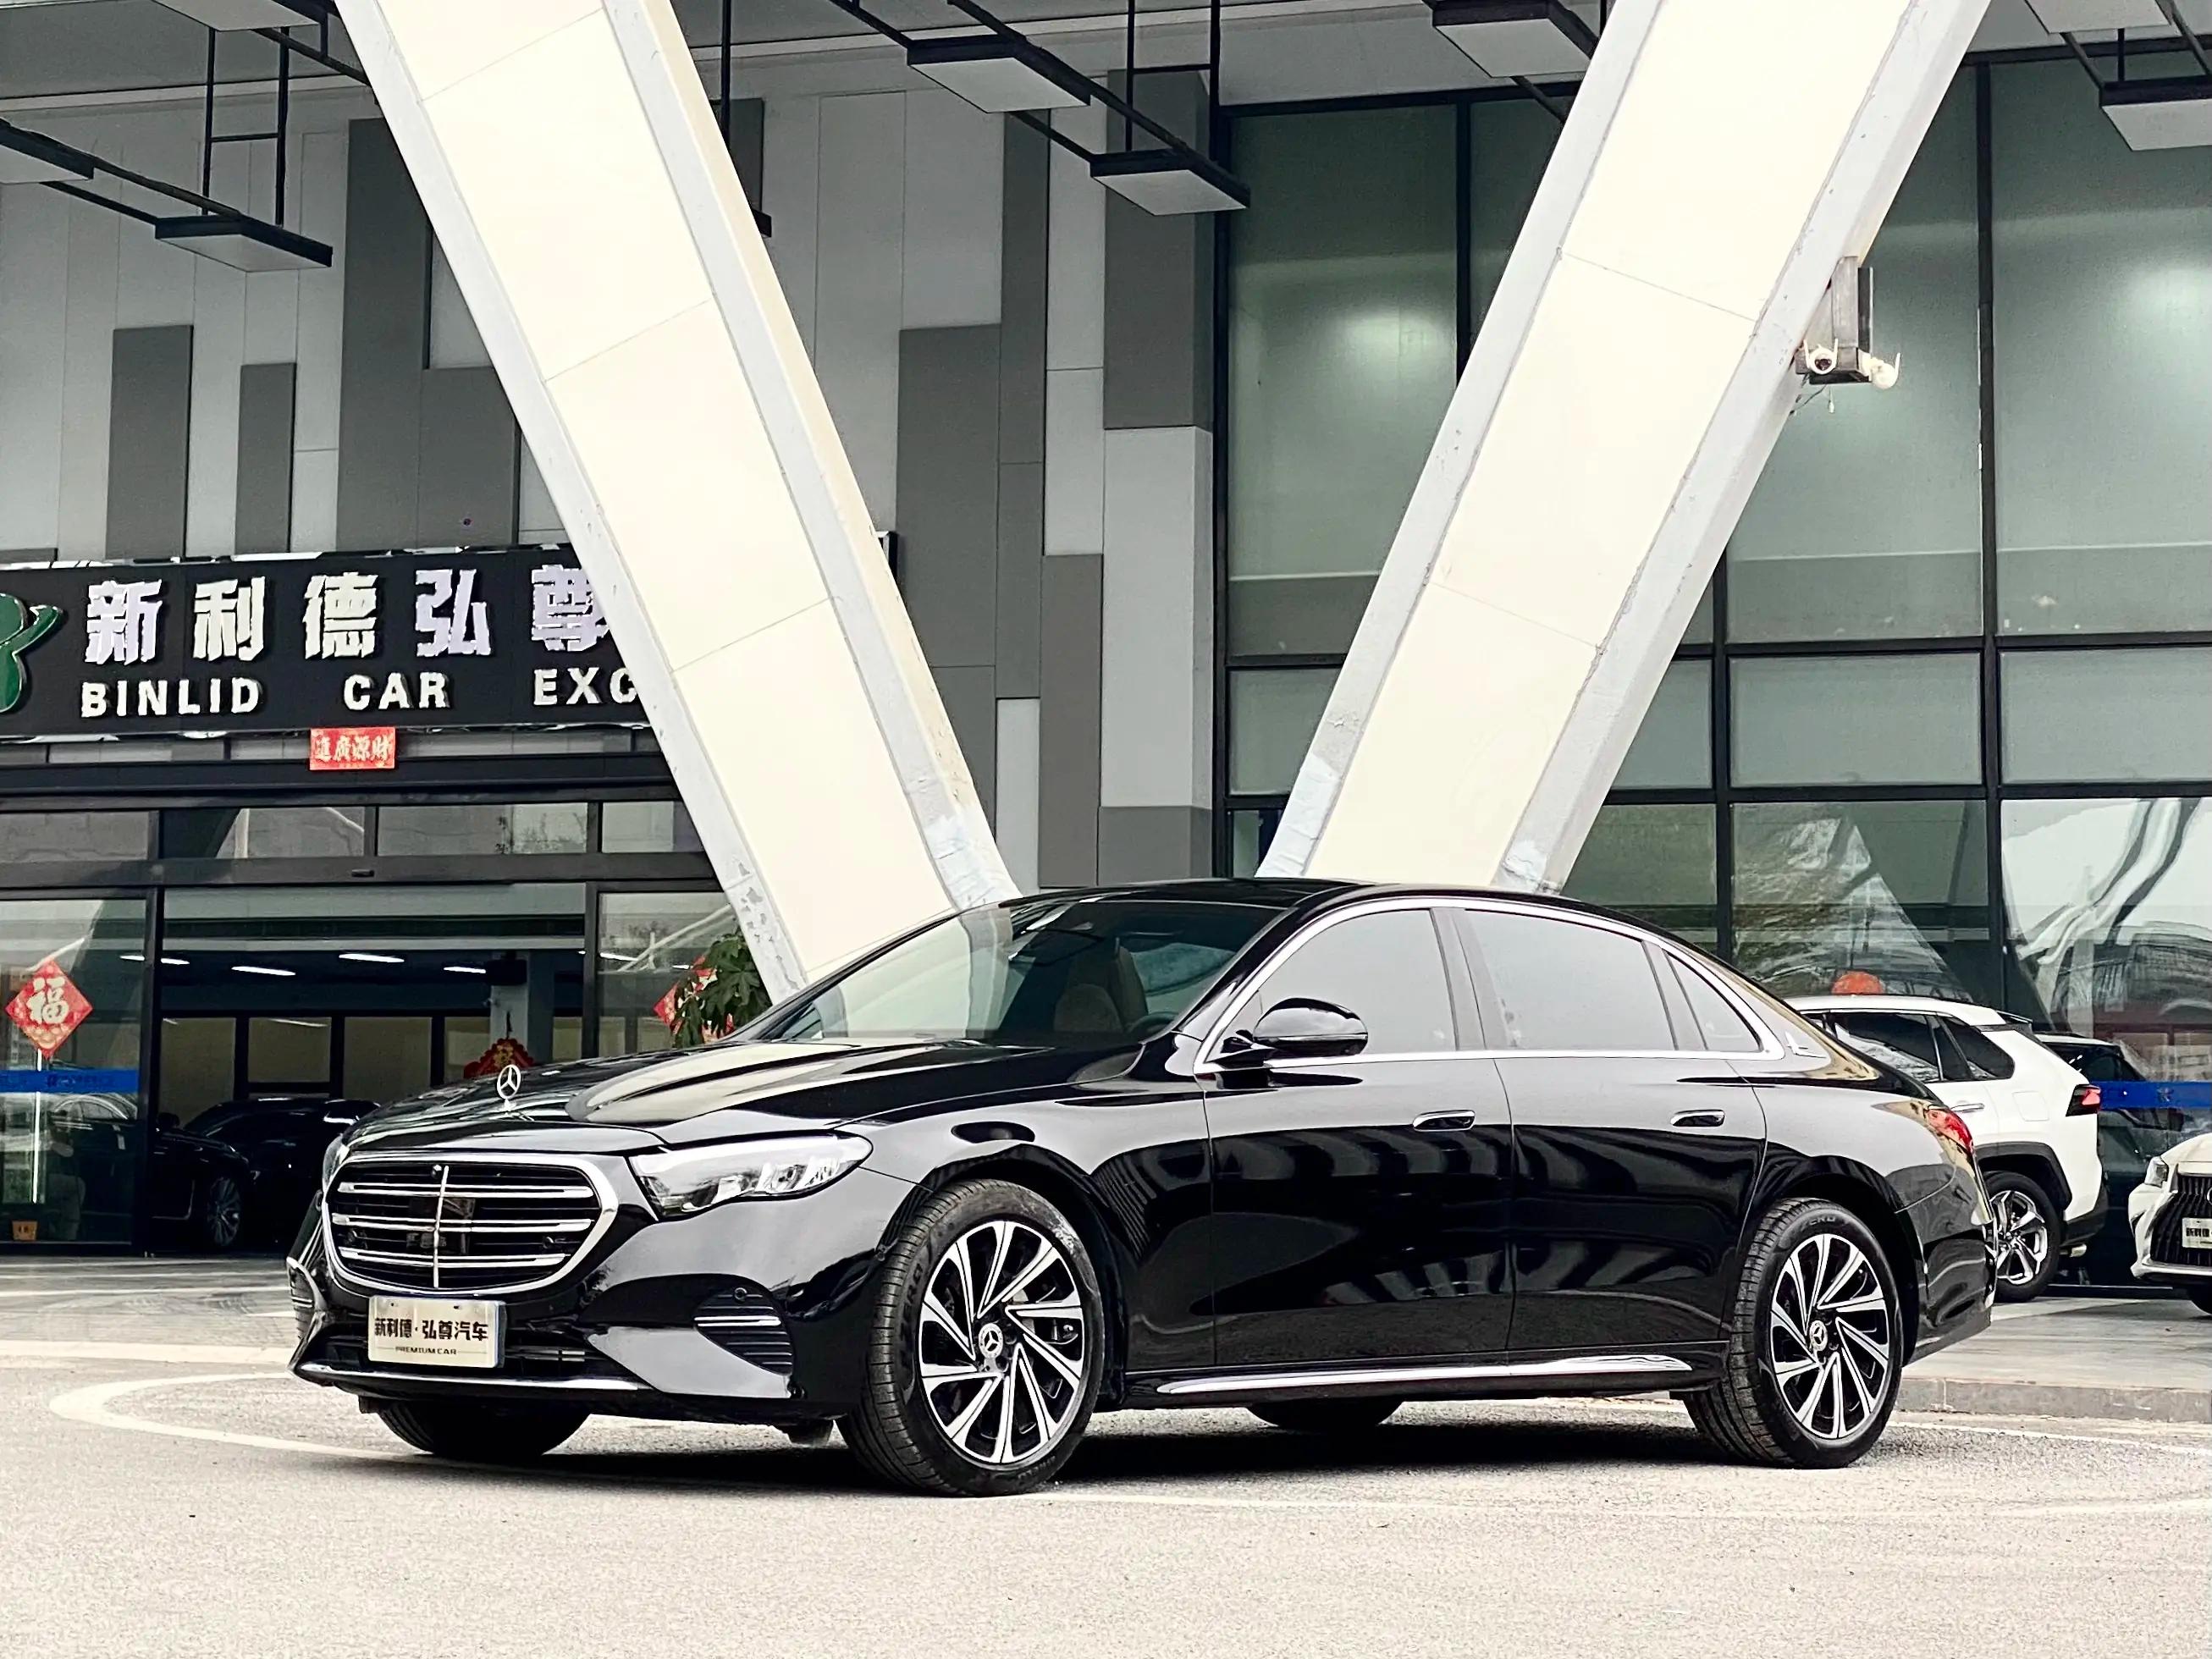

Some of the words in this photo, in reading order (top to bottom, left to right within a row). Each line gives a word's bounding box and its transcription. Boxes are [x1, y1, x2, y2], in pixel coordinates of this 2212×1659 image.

[85, 565, 609, 665] 新利德弘尊
[81, 677, 260, 718] BINLID
[344, 672, 450, 711] CAR
[26, 977, 69, 1025] 福
